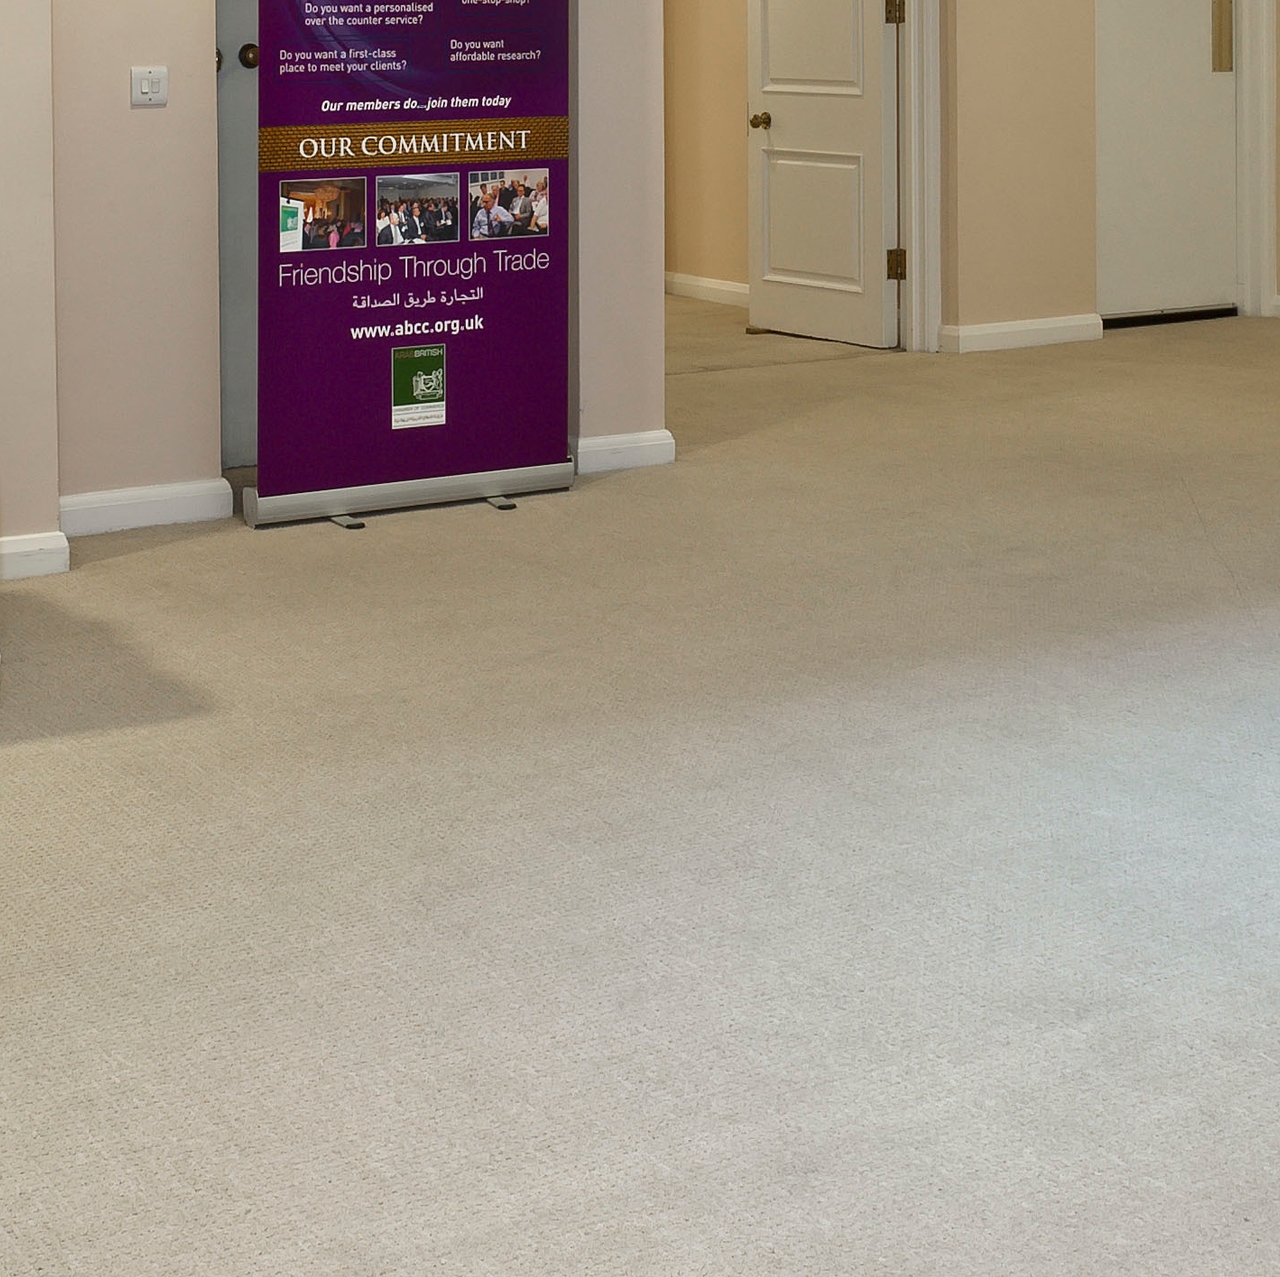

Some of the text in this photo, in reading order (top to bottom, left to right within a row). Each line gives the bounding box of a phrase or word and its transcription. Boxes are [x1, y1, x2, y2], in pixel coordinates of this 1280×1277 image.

[450, 39, 503, 52] Do you want
[450, 49, 541, 61] affordable research?
[321, 99, 343, 111] Our
[345, 98, 400, 110] members
[450, 96, 478, 107] them
[481, 94, 511, 108] today
[299, 129, 531, 158] OUR COMMITMENT
[279, 247, 549, 286] Friendship Through Trade
[352, 286, 484, 308] التجارة طريق الصداقة
[350, 314, 483, 339] www.abcc.org.uk
